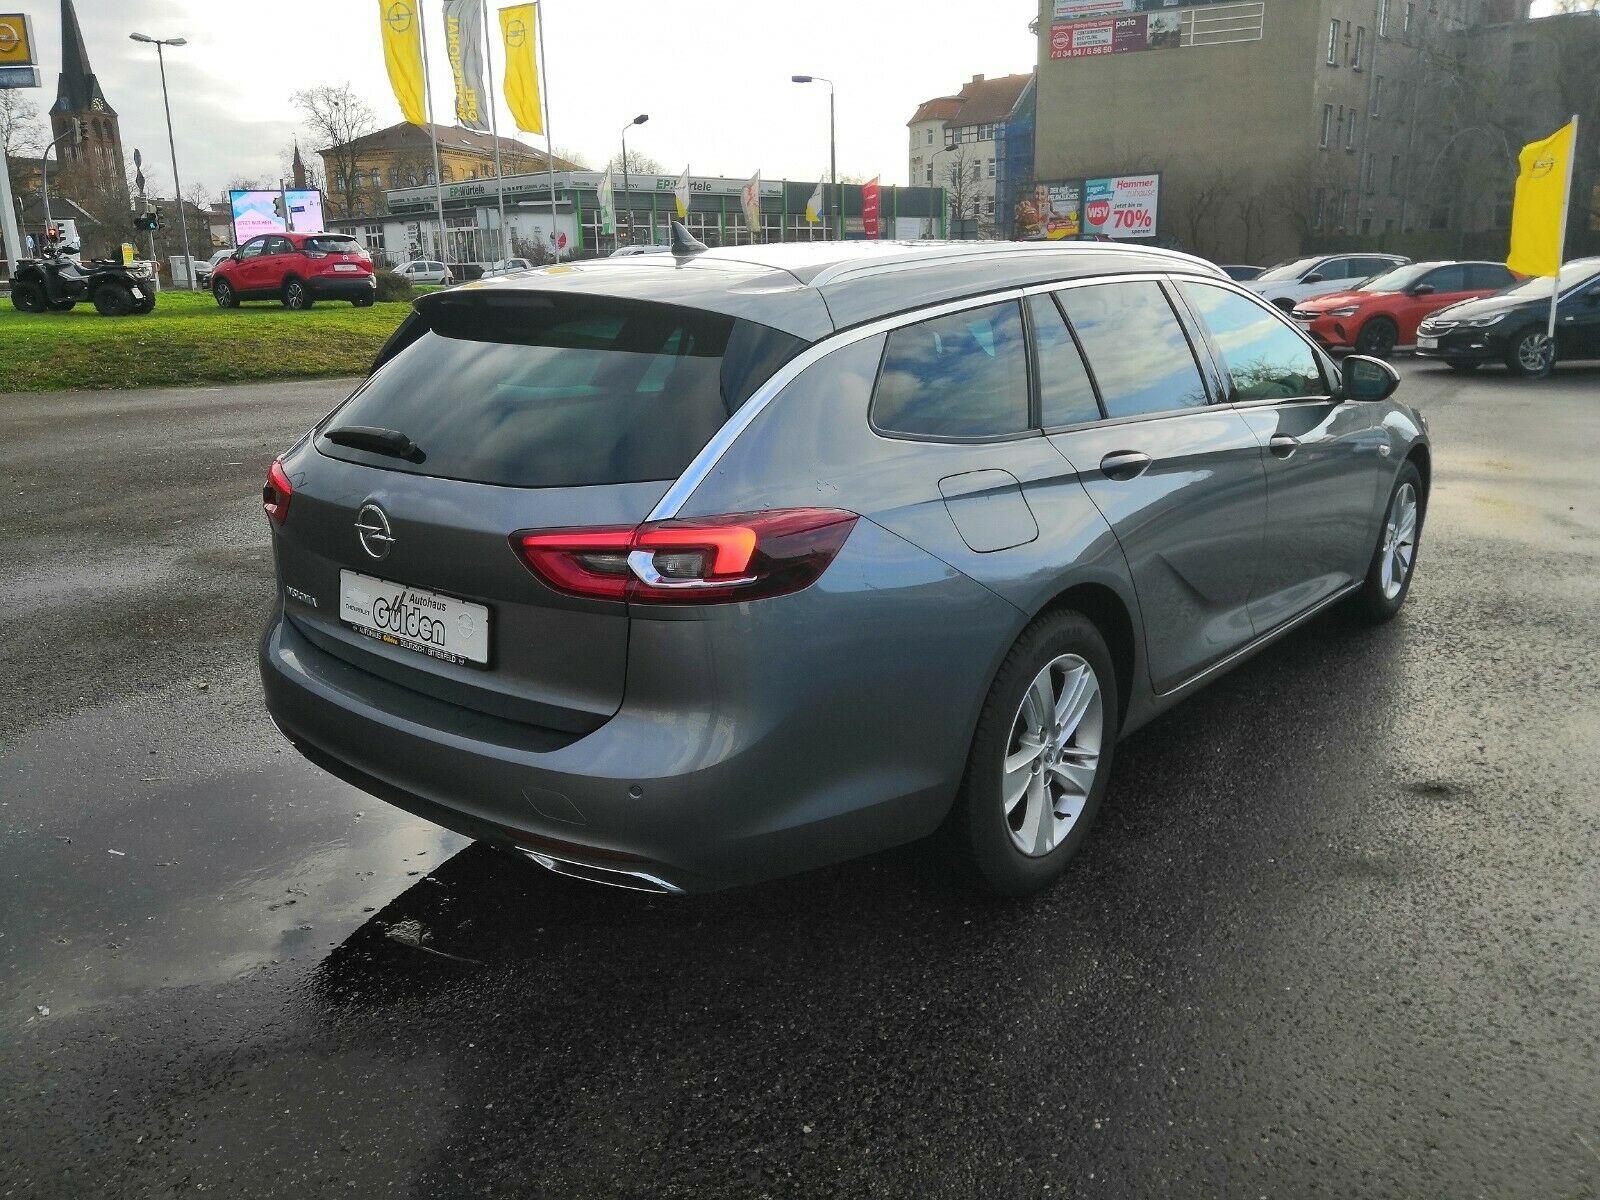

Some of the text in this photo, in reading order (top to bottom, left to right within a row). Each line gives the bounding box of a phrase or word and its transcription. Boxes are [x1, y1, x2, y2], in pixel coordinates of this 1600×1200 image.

[1115, 18, 1136, 28] porta
[1116, 180, 1154, 190] Hammer
[1088, 206, 1109, 217] WSV
[1114, 209, 1152, 228] 70%
[409, 593, 447, 612] Autohaus
[373, 590, 446, 646] Gülden
[359, 626, 382, 640] AUTOHAUS
[428, 647, 457, 663] BITTERFELD
